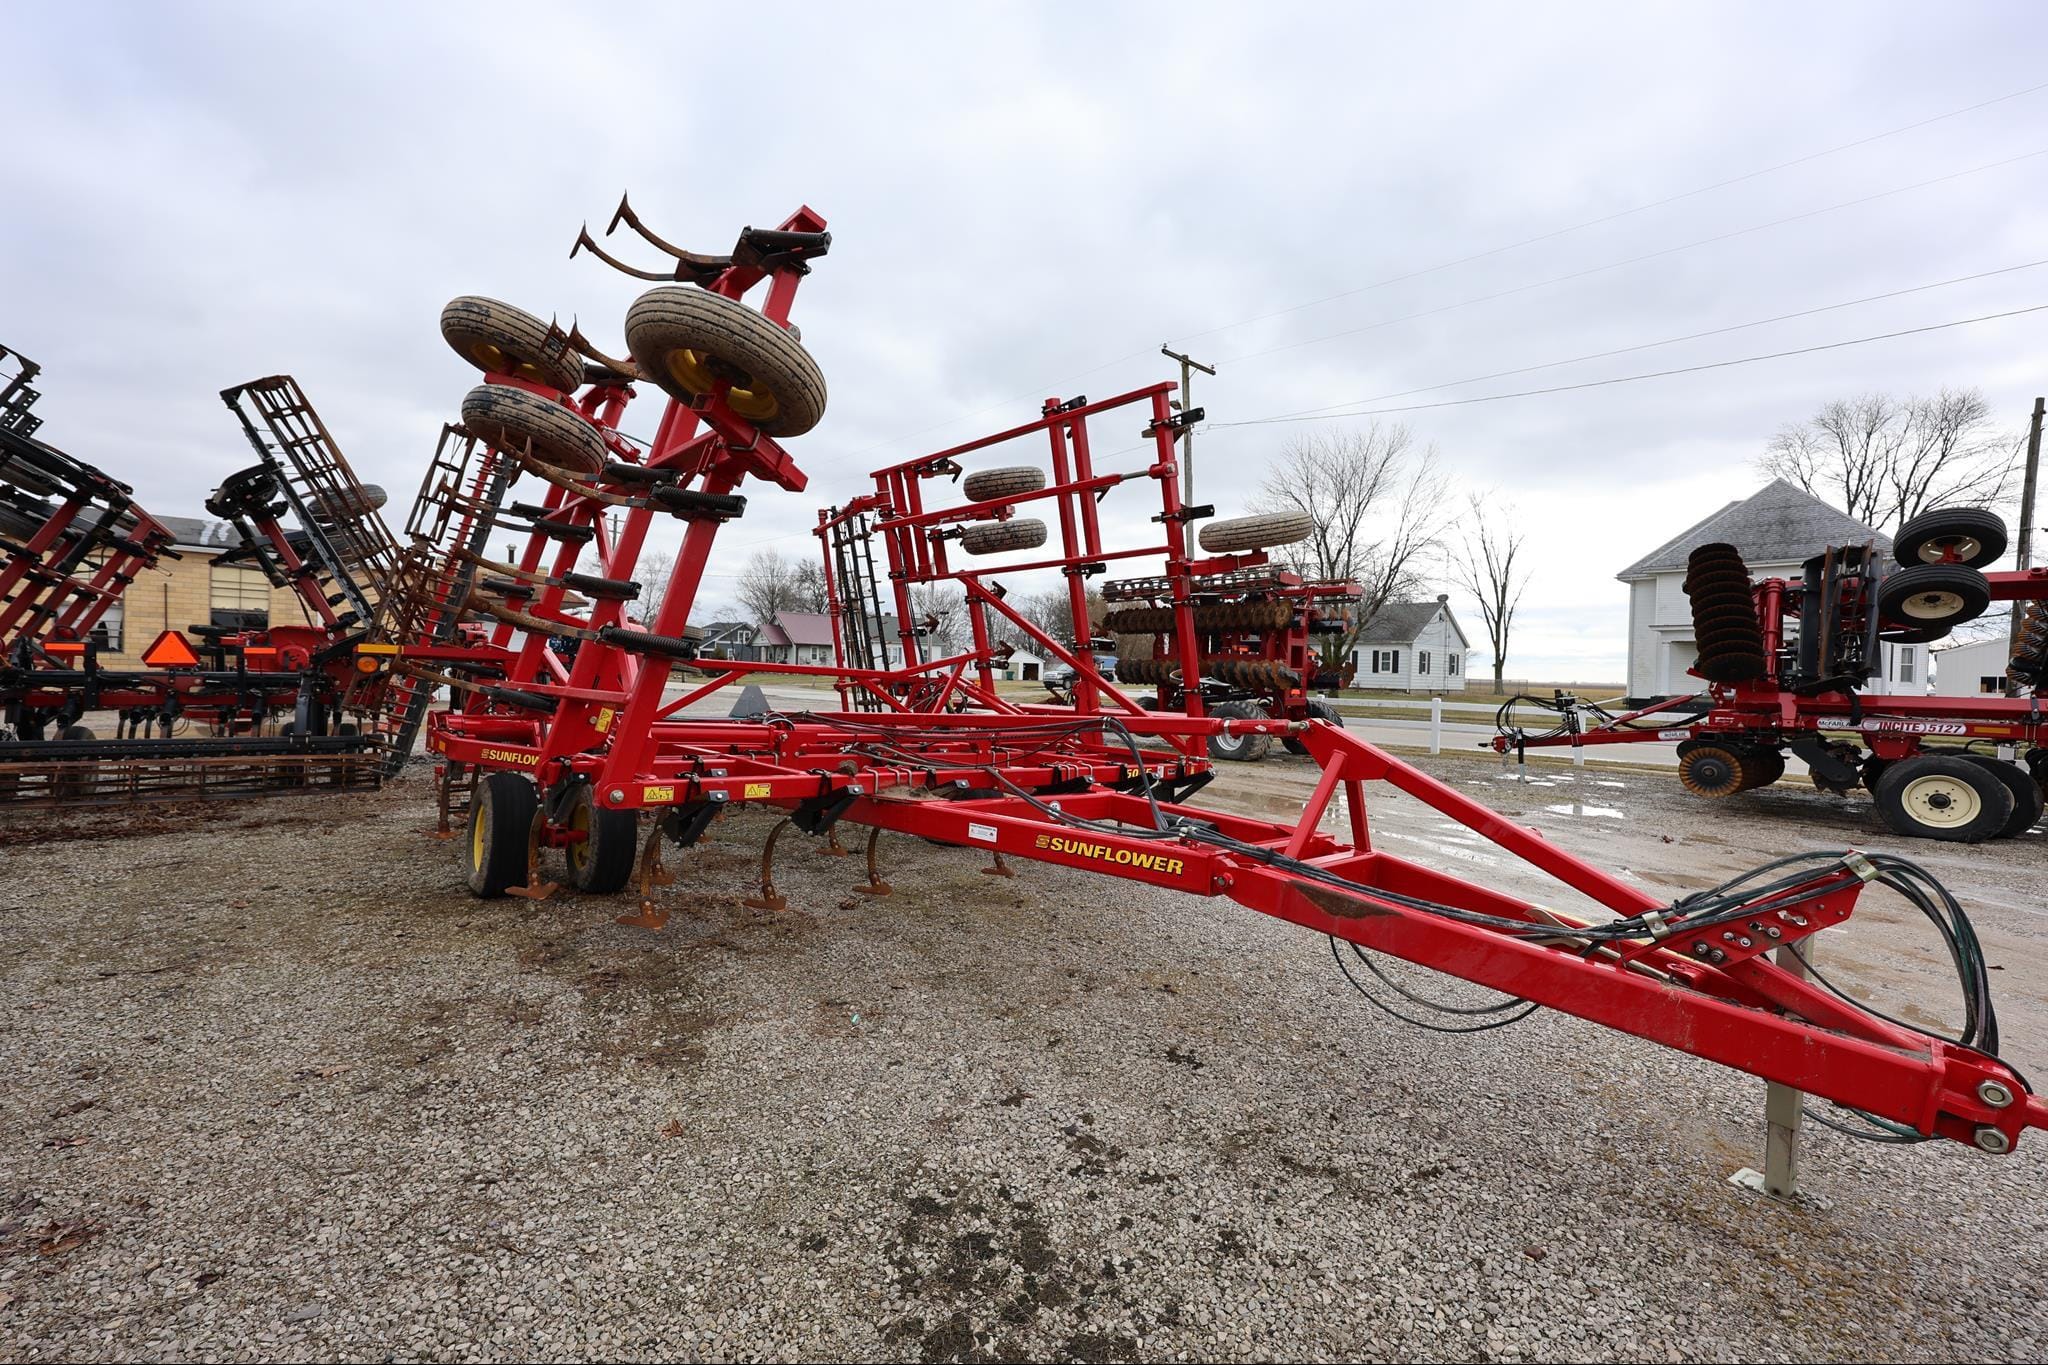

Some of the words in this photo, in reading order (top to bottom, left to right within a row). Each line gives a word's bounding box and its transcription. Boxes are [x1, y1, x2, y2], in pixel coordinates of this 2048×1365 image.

[1879, 721, 1921, 732] INCITE
[1928, 724, 1962, 734] 5127
[1050, 837, 1184, 875] SUNFLOWER
